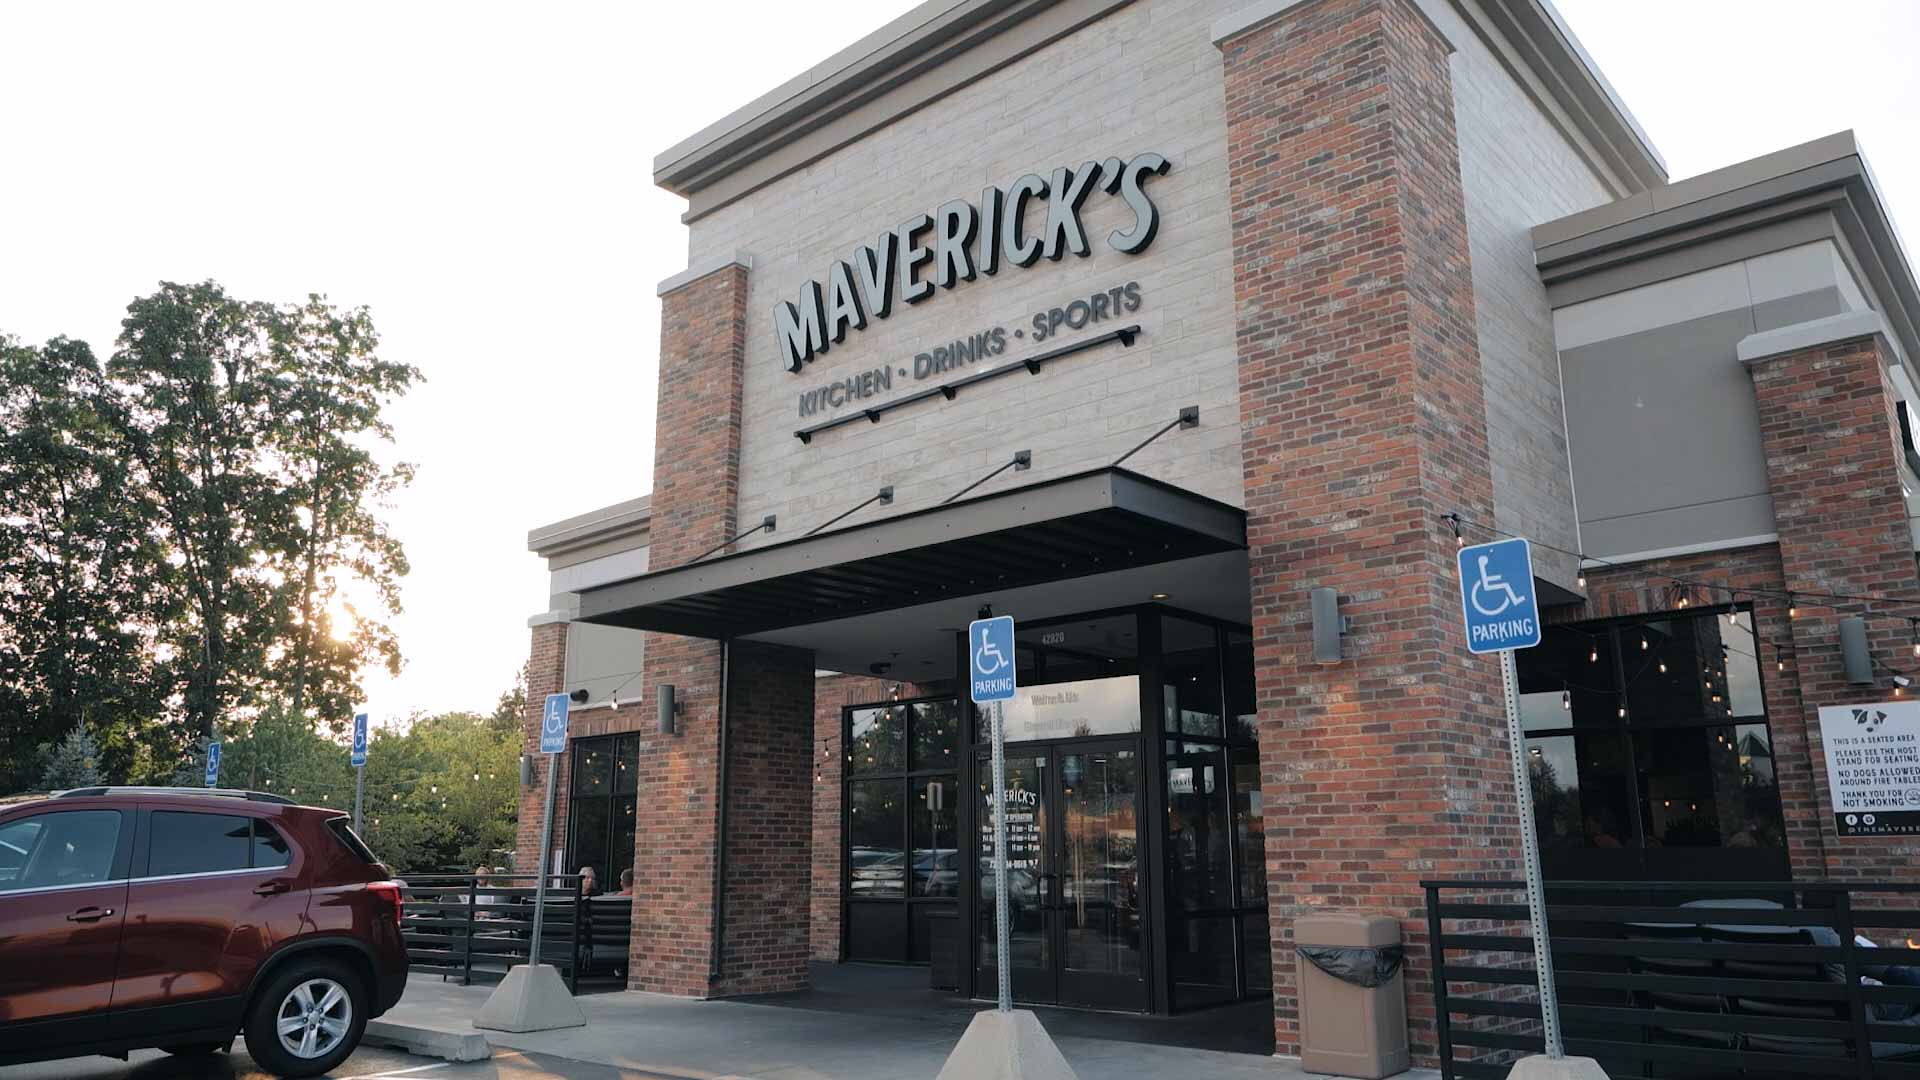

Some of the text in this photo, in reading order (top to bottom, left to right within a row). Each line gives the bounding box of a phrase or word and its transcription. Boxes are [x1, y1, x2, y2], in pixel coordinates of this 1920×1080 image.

[773, 151, 1171, 373] MAVERICK'S
[798, 281, 1142, 417] KITCHEN DRINKS SPORTS
[1472, 618, 1533, 643] PARKING
[975, 678, 1012, 695] PARKING
[1867, 735, 1894, 743] SEATED
[1864, 748, 1877, 756] SEE
[1880, 747, 1894, 755] THE
[1897, 746, 1917, 754] HOST
[1836, 755, 1919, 766] STAND FOR SEATING
[1853, 769, 1877, 777] DOGS
[1880, 766, 1920, 776] ALLOWED
[1840, 778, 1871, 786] AROUND
[1874, 777, 1890, 785] FIRE
[985, 788, 1036, 808] MERICK'S
[1869, 790, 1885, 798] YOU
[1887, 789, 1902, 797] FOR
[1843, 798, 1904, 808] NOT SMOKING
